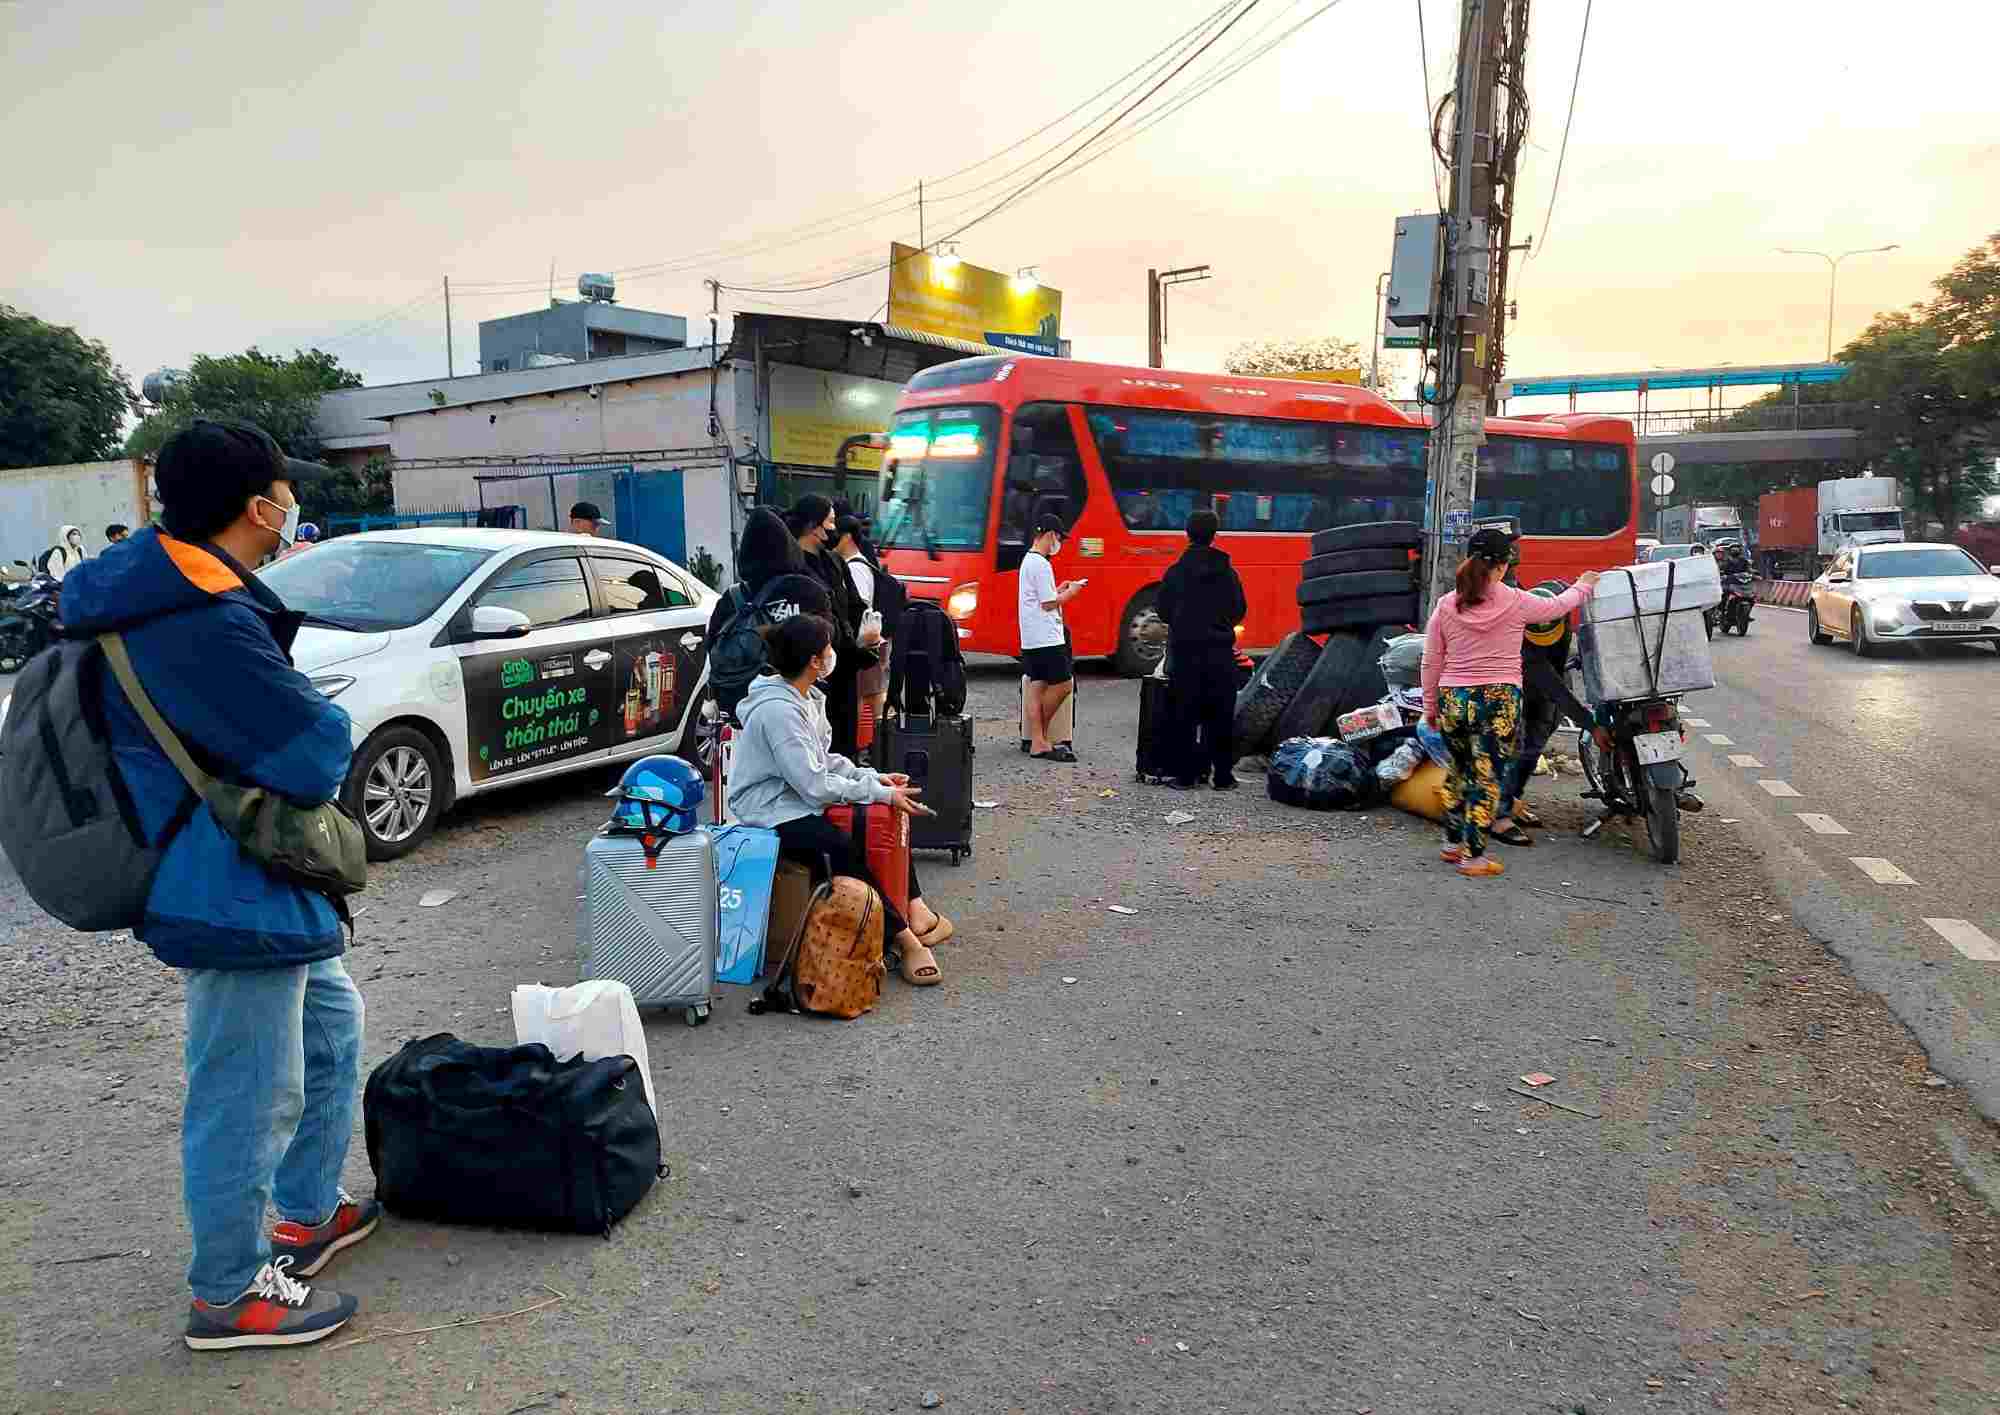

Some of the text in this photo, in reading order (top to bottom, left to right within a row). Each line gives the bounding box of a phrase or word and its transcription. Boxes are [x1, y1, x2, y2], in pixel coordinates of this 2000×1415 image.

[503, 658, 529, 673] Grab
[502, 685, 586, 719] Chuyến xe
[548, 711, 580, 737] thái
